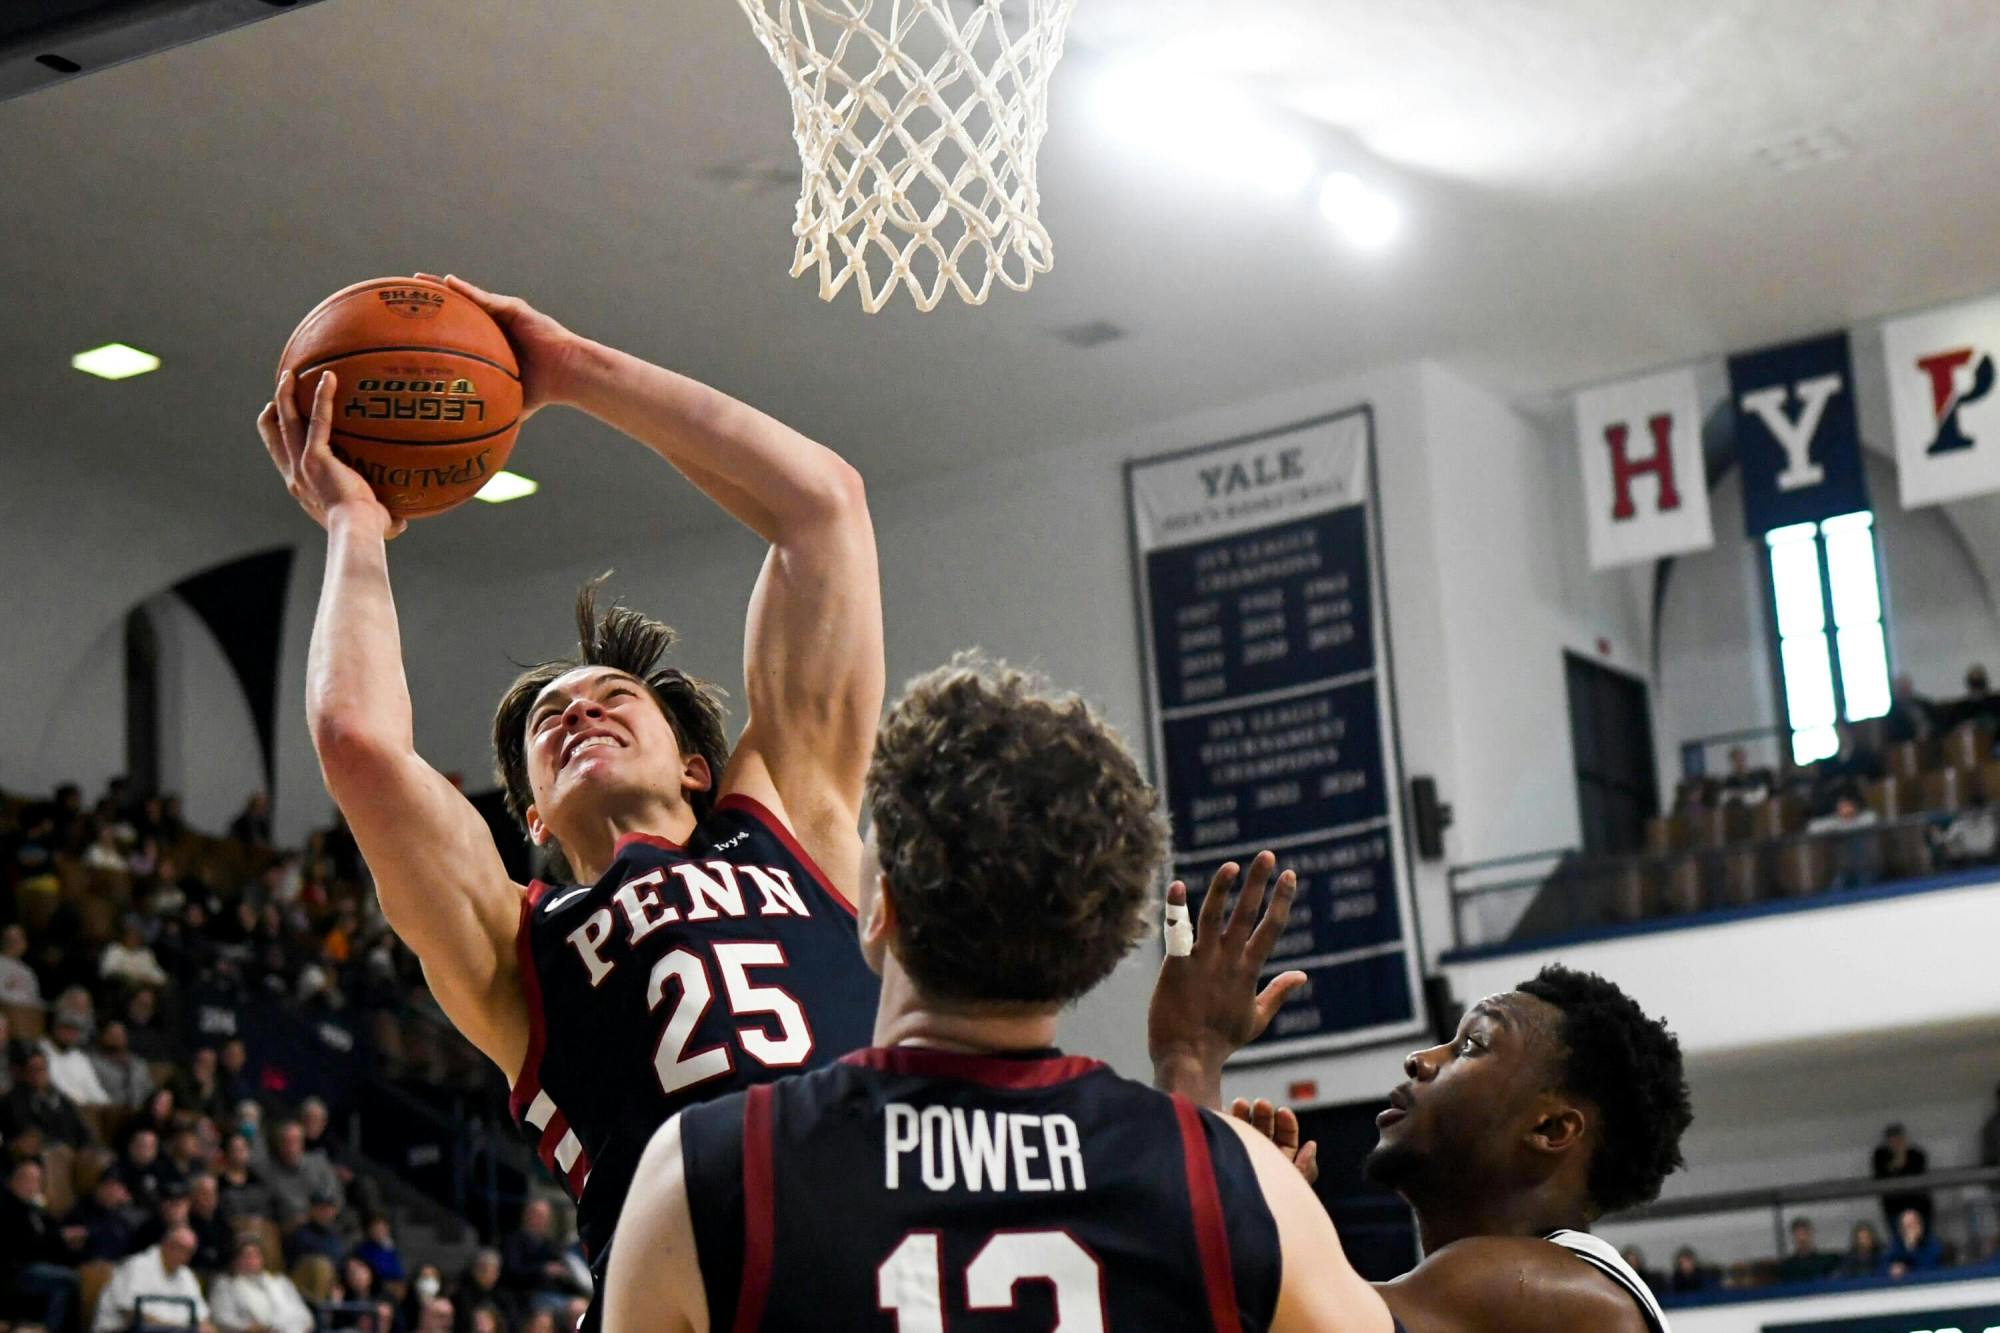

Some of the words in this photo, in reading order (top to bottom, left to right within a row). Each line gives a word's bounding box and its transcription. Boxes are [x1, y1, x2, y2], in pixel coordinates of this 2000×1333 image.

[345, 397, 485, 423] LEGACY
[1741, 372, 1843, 493] Y
[1915, 346, 1997, 458] P
[336, 447, 492, 489] SPALDIN
[1199, 448, 1304, 498] YALE
[1604, 412, 1681, 521] H
[566, 859, 813, 989] PENN
[646, 939, 816, 1096] 25
[885, 1102, 1087, 1192] POWER
